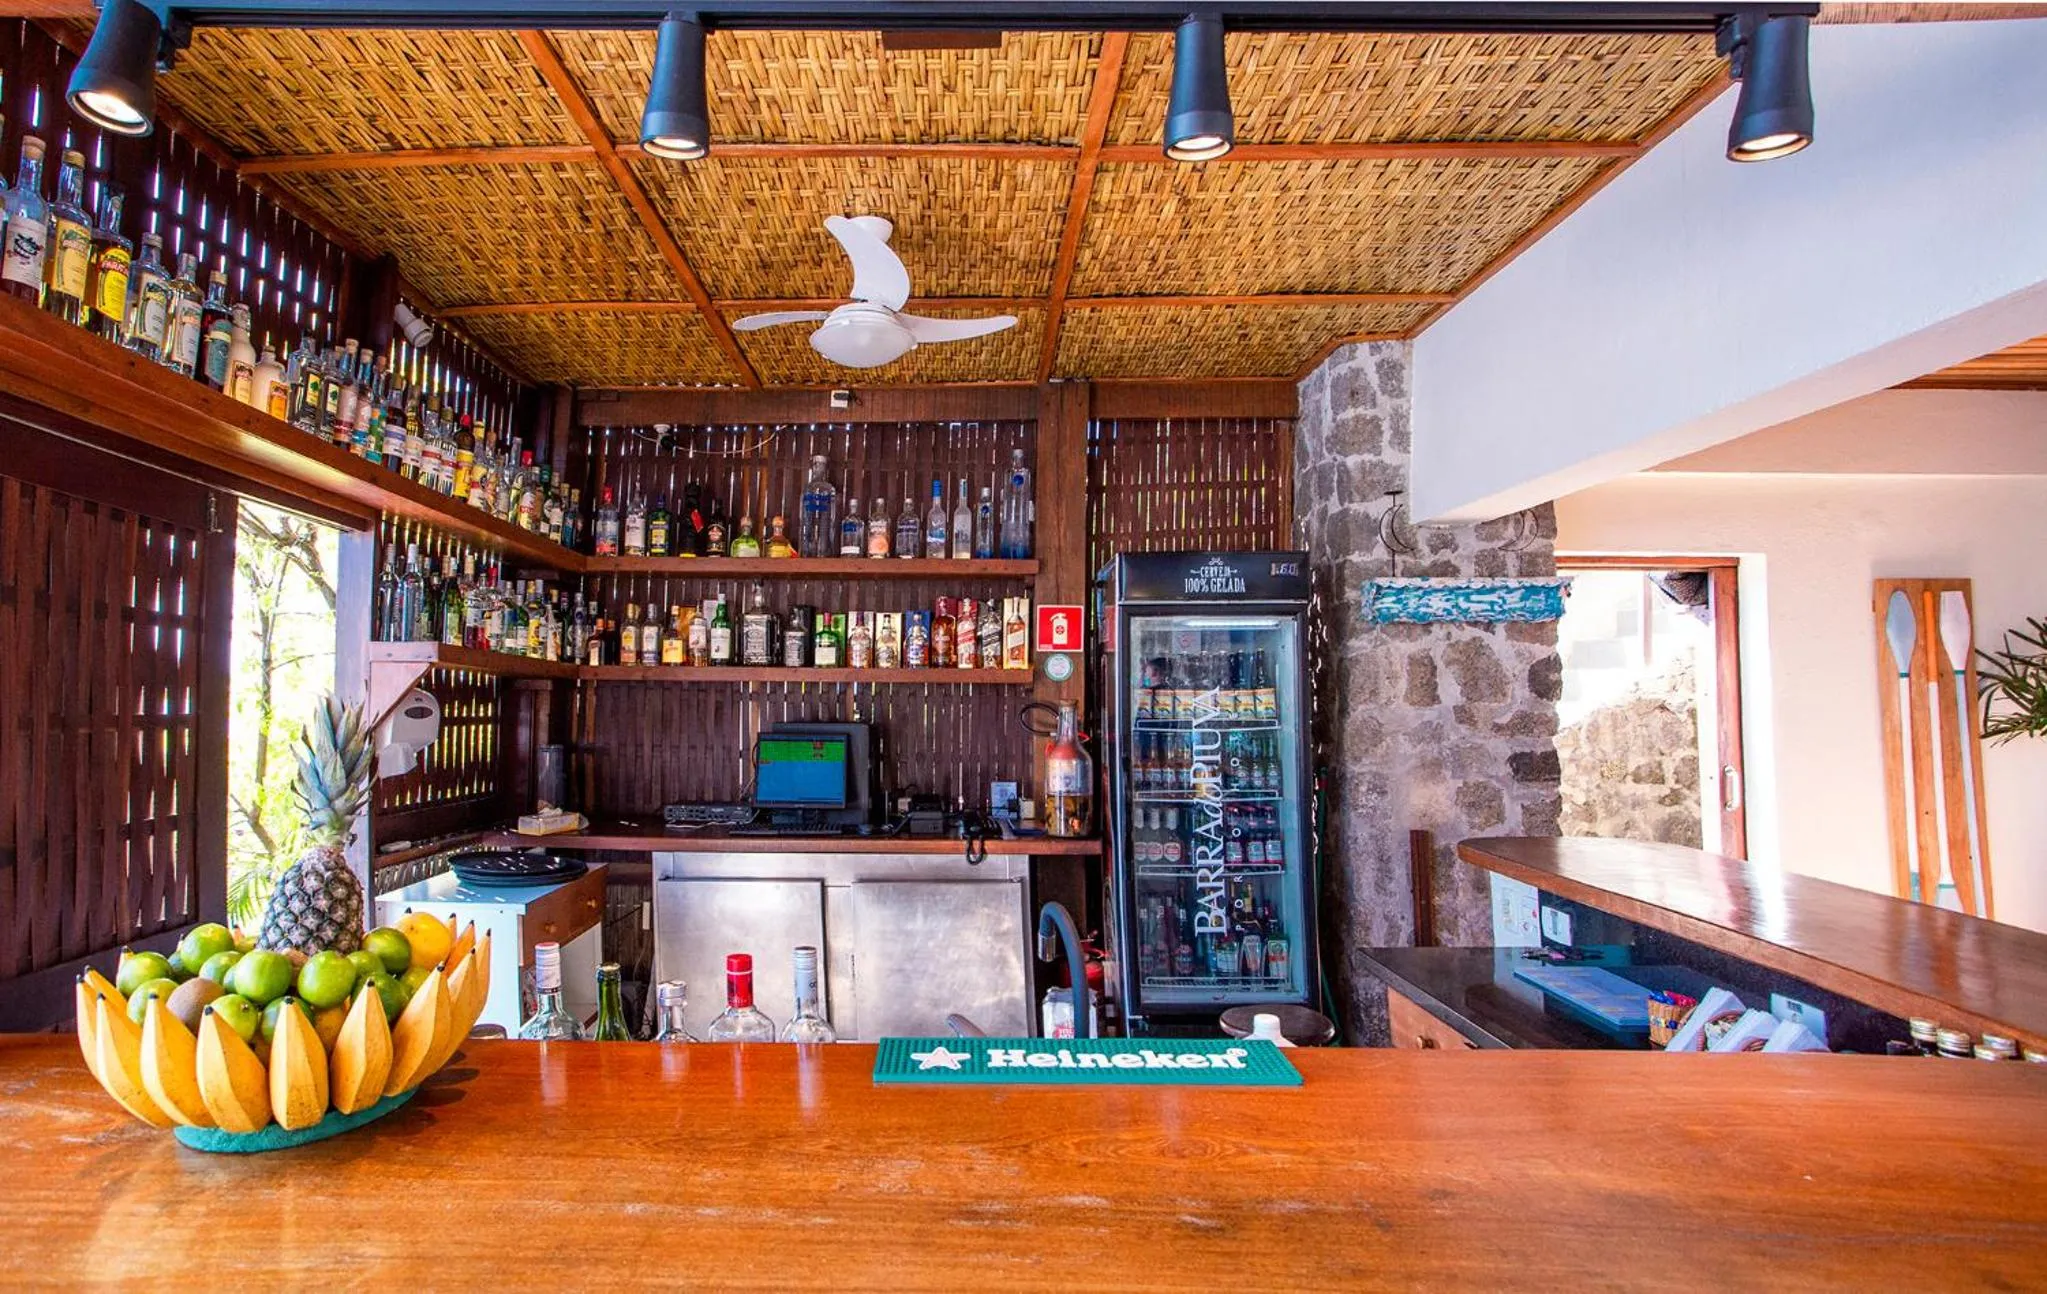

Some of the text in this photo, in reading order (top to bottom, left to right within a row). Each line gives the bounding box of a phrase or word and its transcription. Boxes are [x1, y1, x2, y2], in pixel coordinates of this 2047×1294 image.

[1200, 566, 1231, 578] CERVEJA
[1184, 578, 1246, 593] 100% GELADA
[987, 1048, 1247, 1070] Heineken
